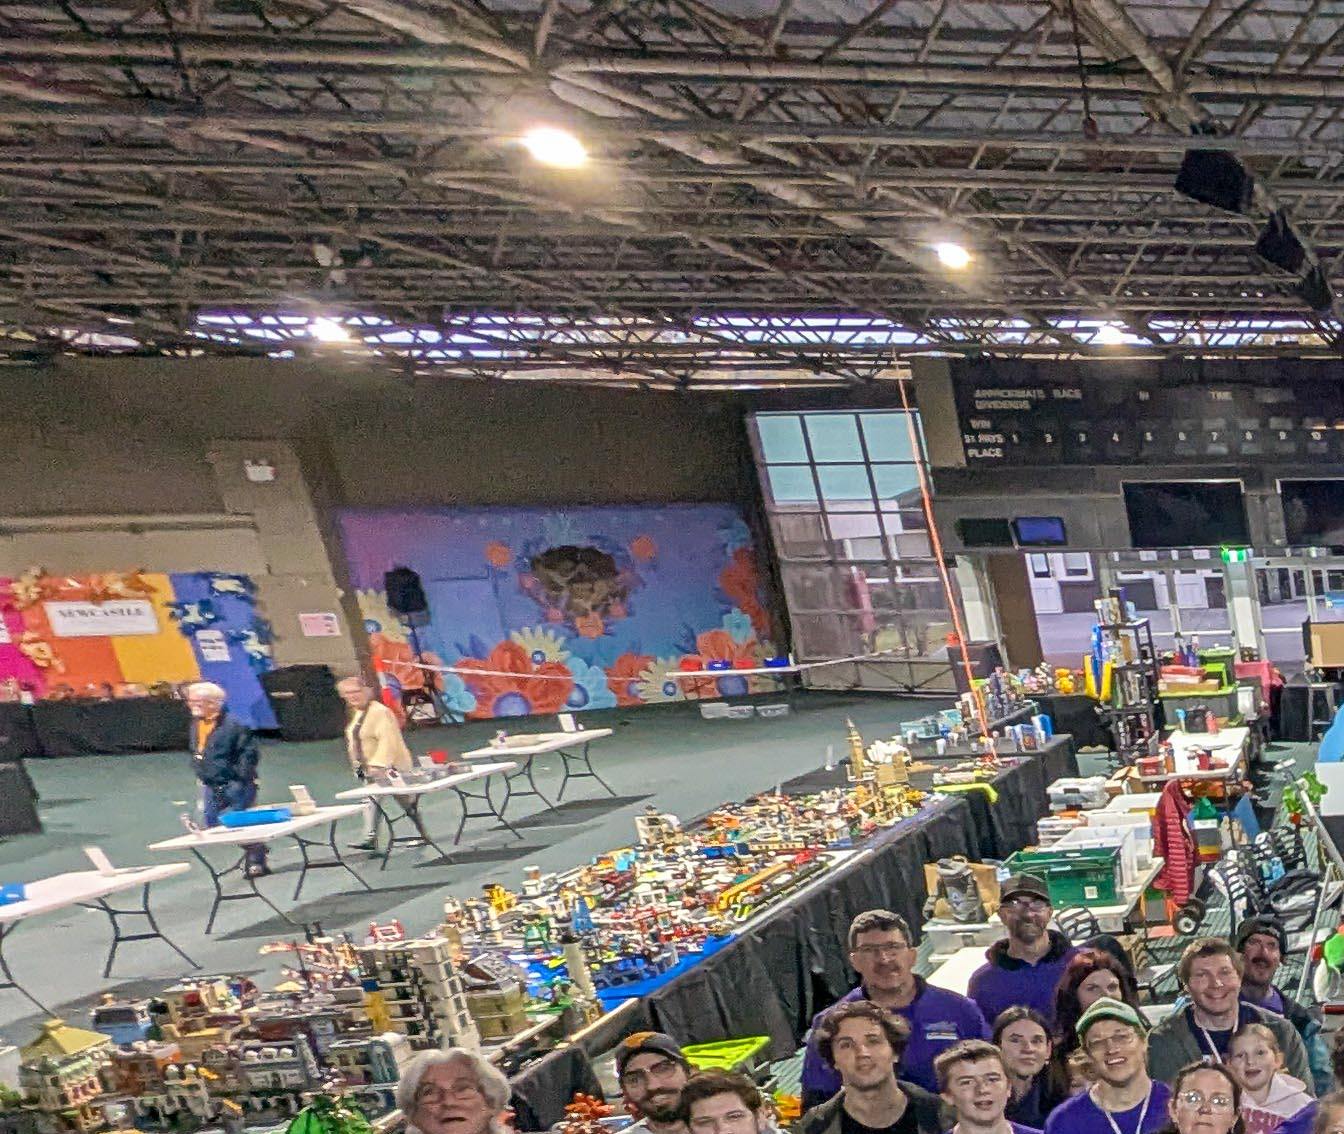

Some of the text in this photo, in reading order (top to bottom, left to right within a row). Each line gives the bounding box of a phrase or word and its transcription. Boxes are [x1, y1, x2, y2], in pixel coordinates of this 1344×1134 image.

[970, 418, 991, 430] WIN
[967, 447, 1003, 458] PLACE
[57, 606, 146, 619] NEWCASTLE
